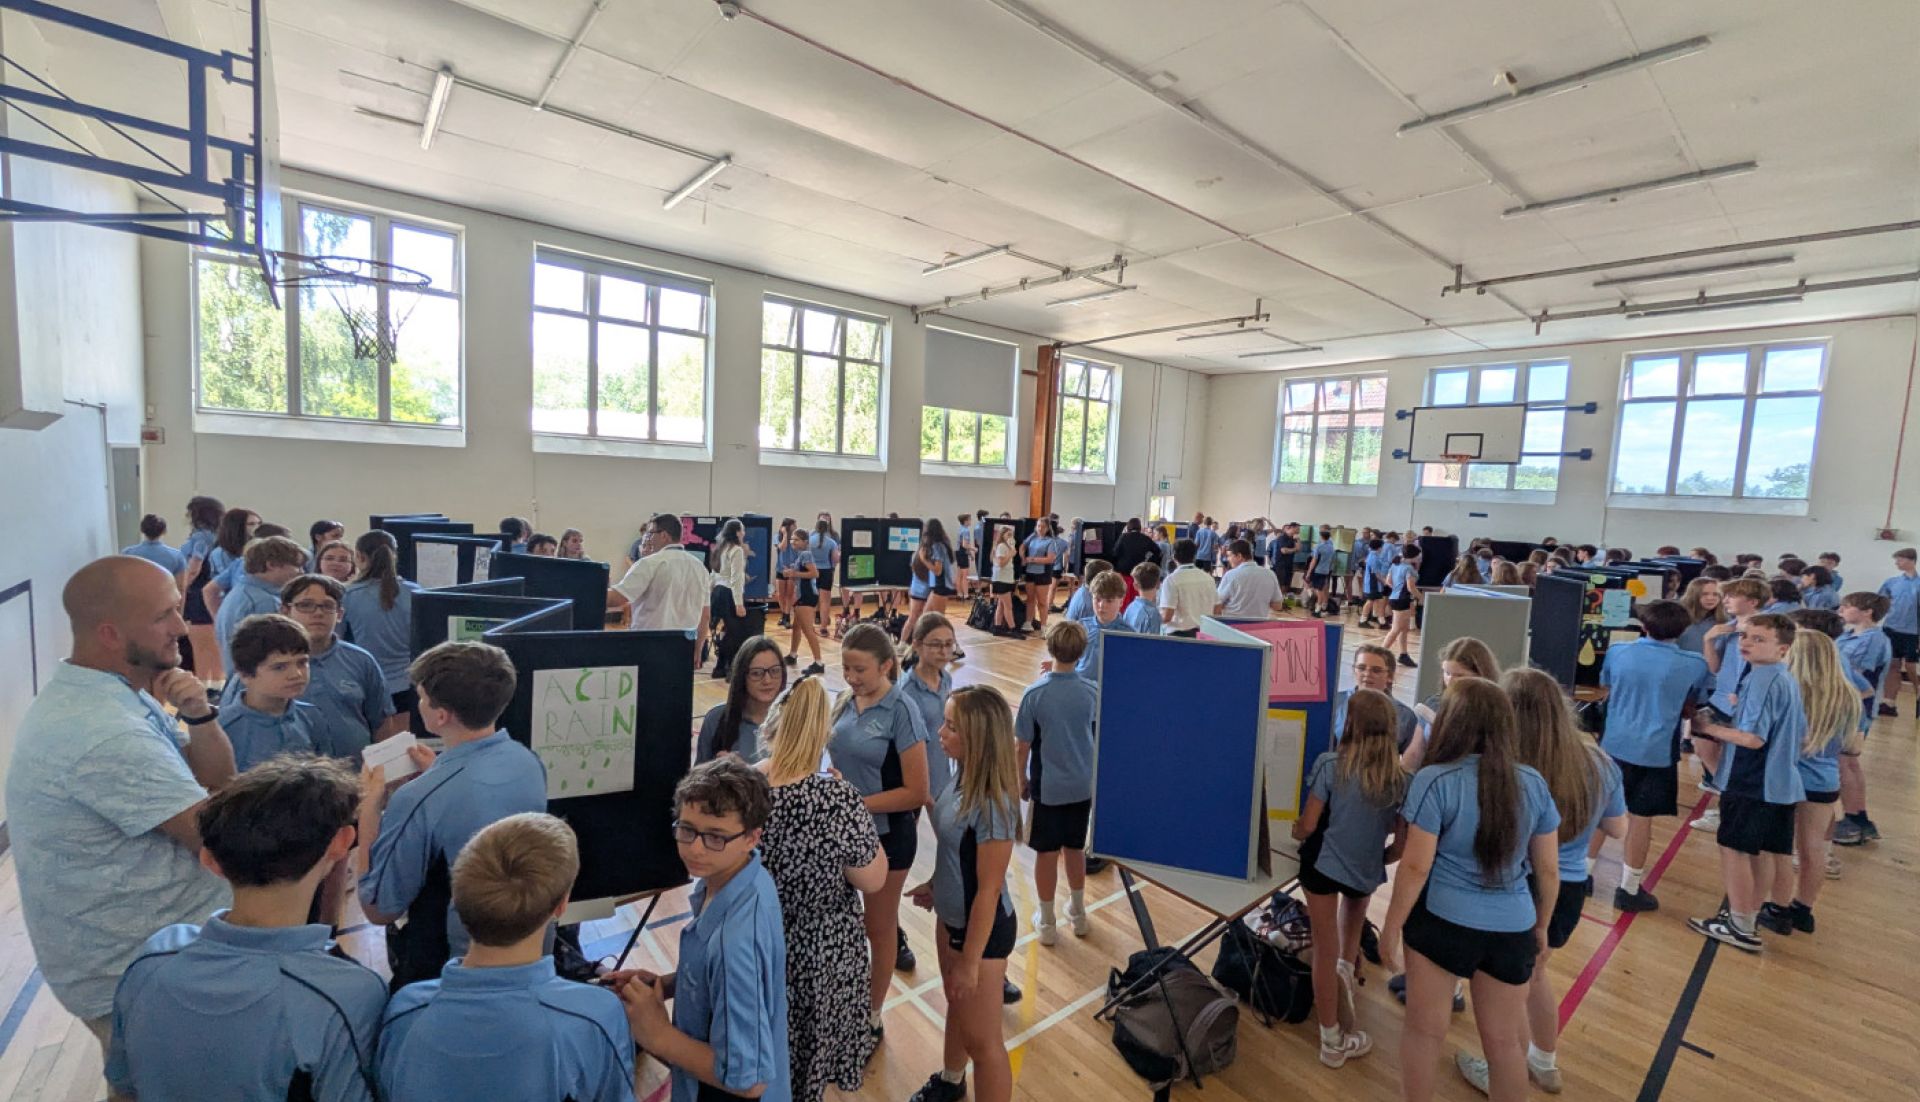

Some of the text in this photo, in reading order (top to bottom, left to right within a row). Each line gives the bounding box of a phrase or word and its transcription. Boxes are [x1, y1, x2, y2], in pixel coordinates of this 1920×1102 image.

[1270, 636, 1320, 686] MING
[543, 669, 633, 706] ACID
[545, 704, 635, 743] RAIN
